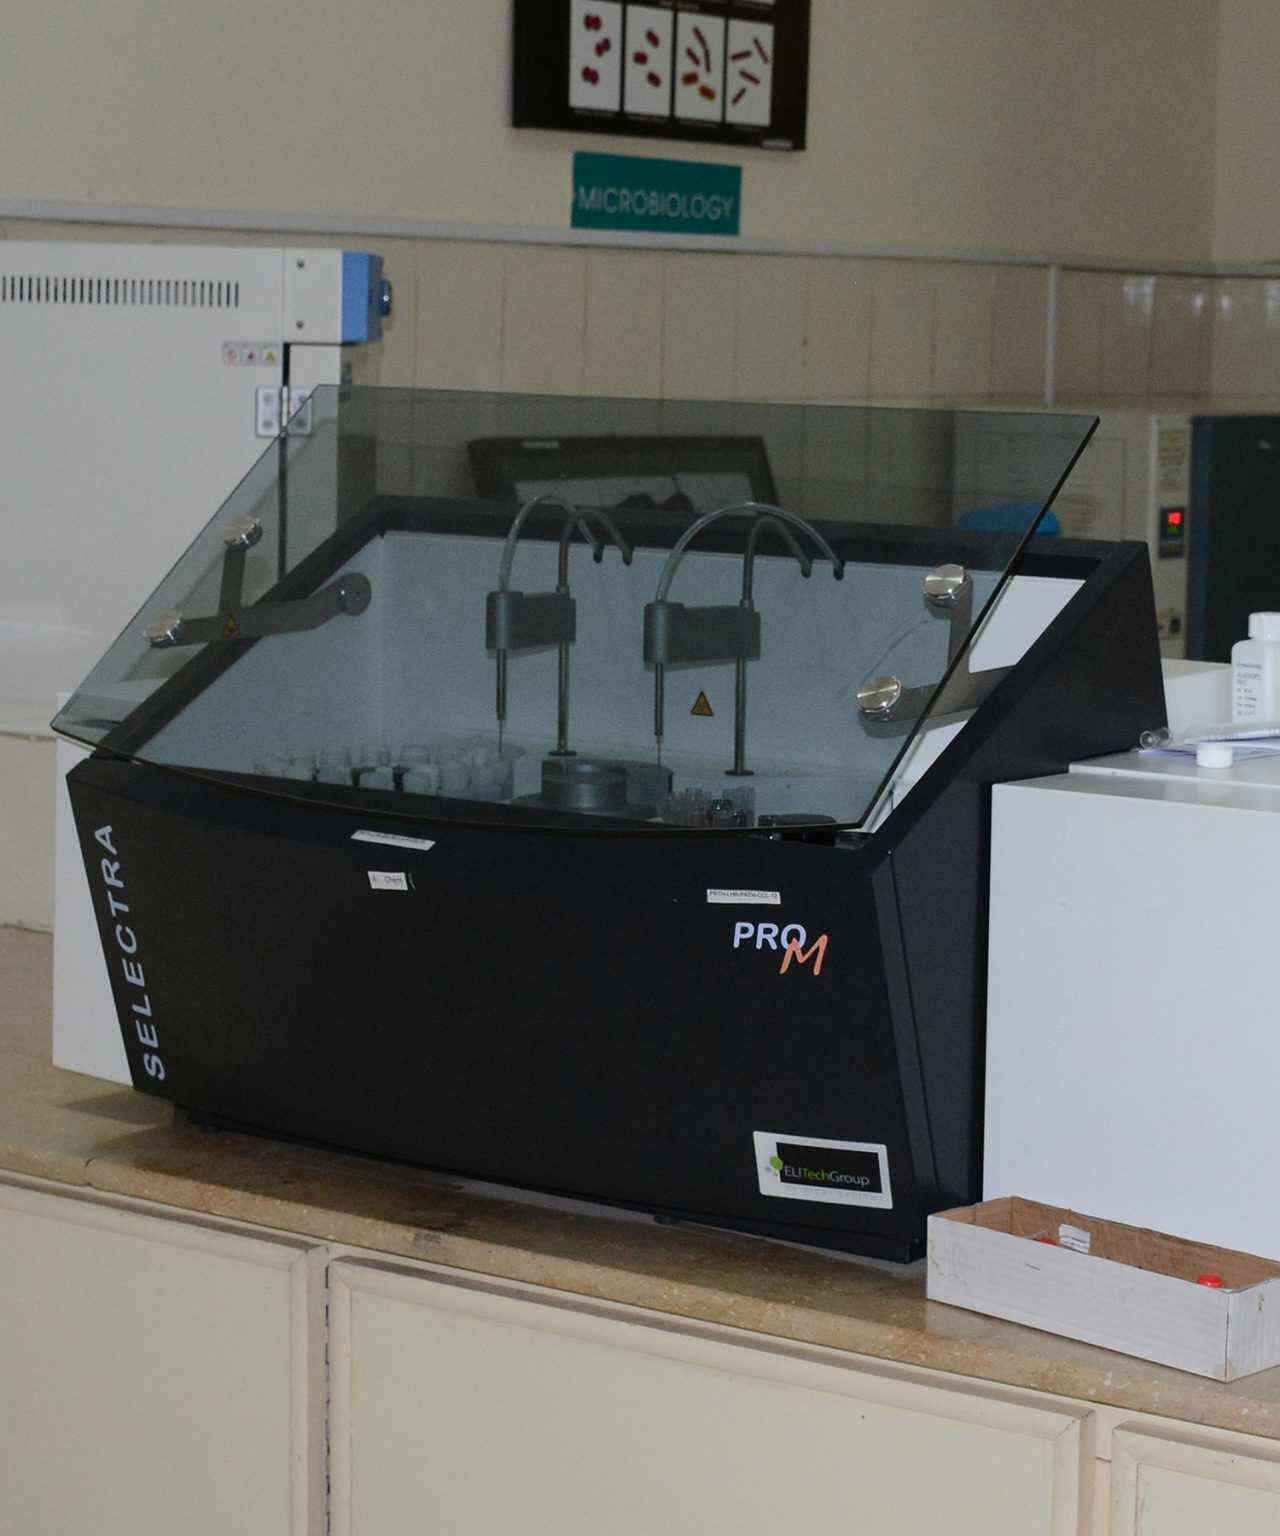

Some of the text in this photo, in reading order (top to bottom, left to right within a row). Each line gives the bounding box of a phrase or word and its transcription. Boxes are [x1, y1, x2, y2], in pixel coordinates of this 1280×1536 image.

[577, 185, 734, 220] MICROBIOLOGY
[94, 825, 166, 1081] SELECTRA
[733, 921, 807, 950] PRO
[779, 934, 828, 975] M
[784, 1165, 870, 1188] ELITechGroup
